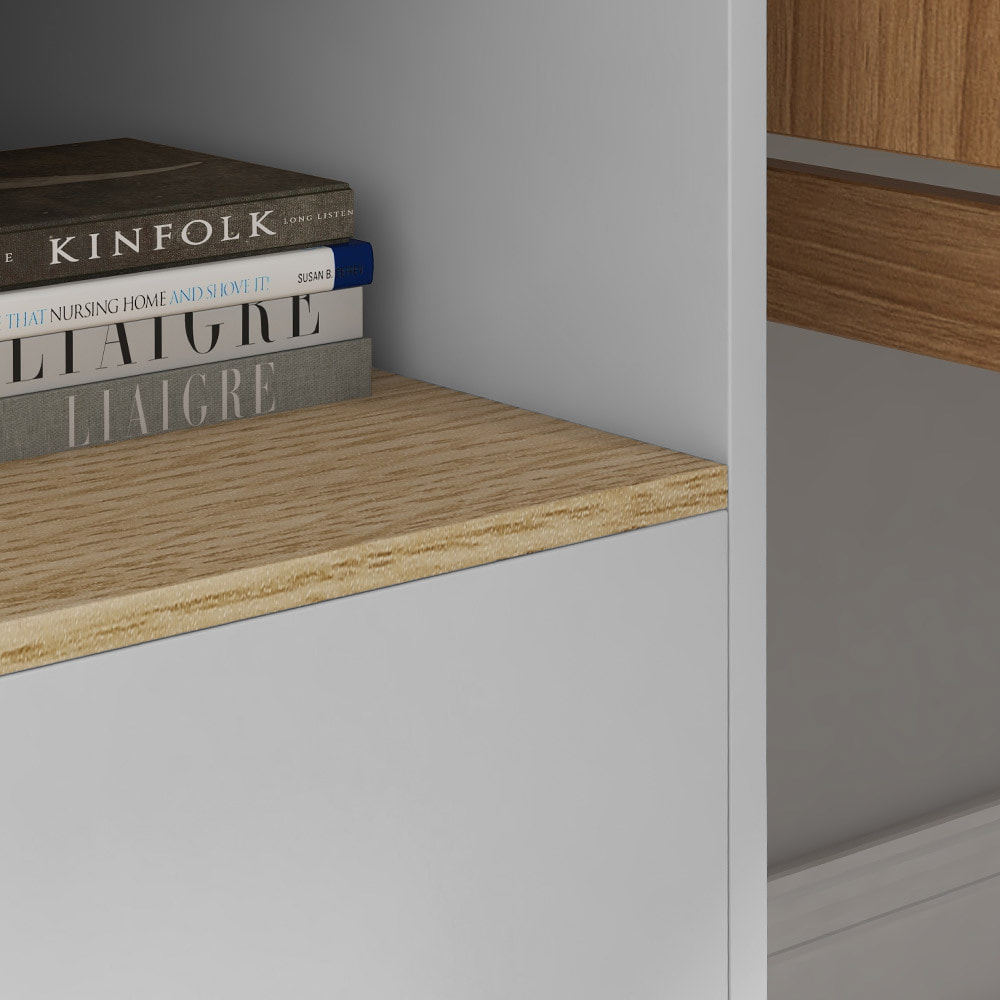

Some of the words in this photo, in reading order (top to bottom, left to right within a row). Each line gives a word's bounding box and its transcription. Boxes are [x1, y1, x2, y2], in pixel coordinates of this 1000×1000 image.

[50, 210, 276, 265] KINFOLK
[283, 213, 313, 225] LONG
[298, 269, 324, 284] SUSAN
[326, 268, 334, 280] B.
[5, 308, 47, 329] THAT
[50, 298, 119, 323] NURSING
[123, 290, 166, 310] HOME
[169, 286, 203, 305] AND
[65, 362, 276, 448] LIAIGRE
